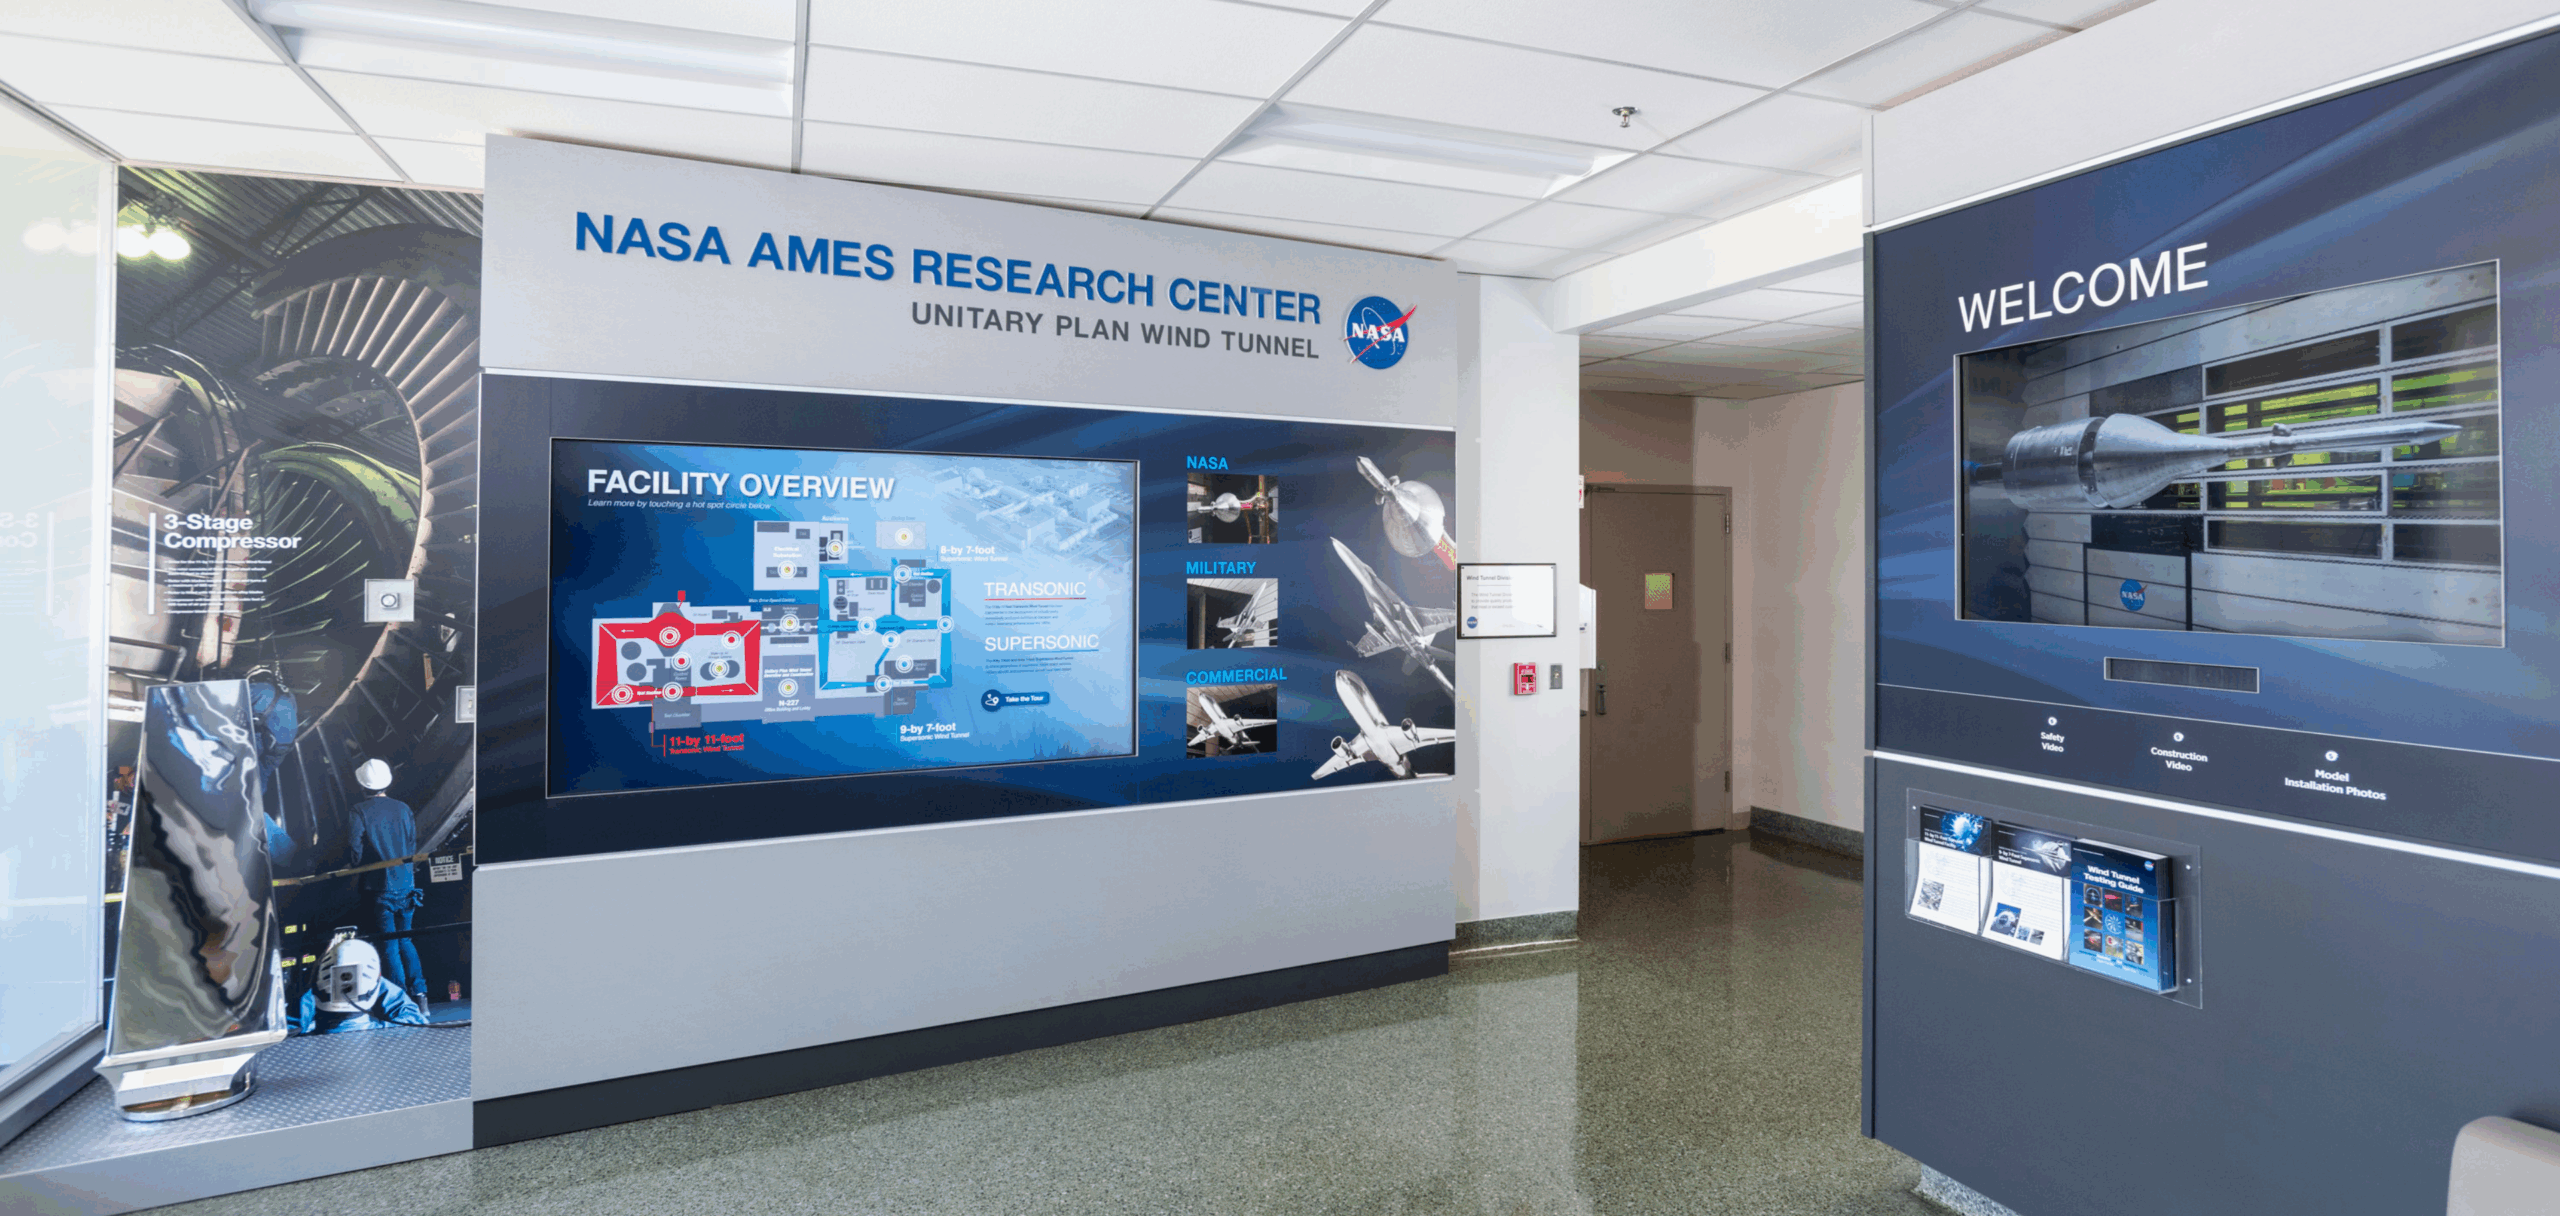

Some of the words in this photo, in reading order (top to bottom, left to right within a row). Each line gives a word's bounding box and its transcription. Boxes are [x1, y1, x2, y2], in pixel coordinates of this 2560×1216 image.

[576, 211, 731, 265] NASA
[747, 232, 894, 281] AMES
[912, 248, 1154, 307] RESEARCH
[1168, 277, 1321, 324] CENTER
[1957, 242, 2209, 333] WELCOME
[911, 301, 1044, 334] UNITARY
[1056, 315, 1130, 342] PLAN
[1140, 323, 1210, 349] WIND
[1220, 330, 1320, 359] TUNNEL
[1352, 322, 1405, 343] NASA
[1187, 455, 1229, 470] NASA
[587, 469, 731, 496] FACILITY
[739, 473, 895, 500] OVERVIEW
[588, 499, 612, 507] Learn
[636, 500, 648, 509] by
[649, 500, 683, 509] touching
[707, 501, 724, 510] spot
[163, 513, 253, 533] 3-Stage
[163, 532, 302, 552] Compressor
[940, 545, 963, 556] 8-by
[966, 545, 995, 554] 7-foot
[1186, 561, 1256, 575] MILITARY
[984, 581, 1086, 597] TRANSONIC
[2121, 590, 2144, 602] NASA
[984, 634, 1100, 651] SUPERSONIC
[1186, 668, 1287, 685] COMMERCIAL
[900, 724, 923, 735] 9-by
[926, 722, 956, 732] 7-foot
[669, 735, 701, 747] 11-by
[704, 733, 744, 744] 11-foot
[900, 734, 933, 742] Supersonic
[2040, 731, 2065, 743] Safety
[2041, 742, 2064, 752] Video
[2150, 747, 2208, 762] Construction
[2165, 760, 2193, 771] Video
[2315, 769, 2350, 782] Model
[2284, 777, 2344, 794] Installation
[2345, 786, 2387, 800] Photos
[435, 855, 454, 864] NOTICE
[2087, 865, 2110, 877] Wind
[2110, 870, 2140, 884] Tunnel
[2083, 872, 2117, 888] Testing
[2117, 881, 2145, 894] Guide
